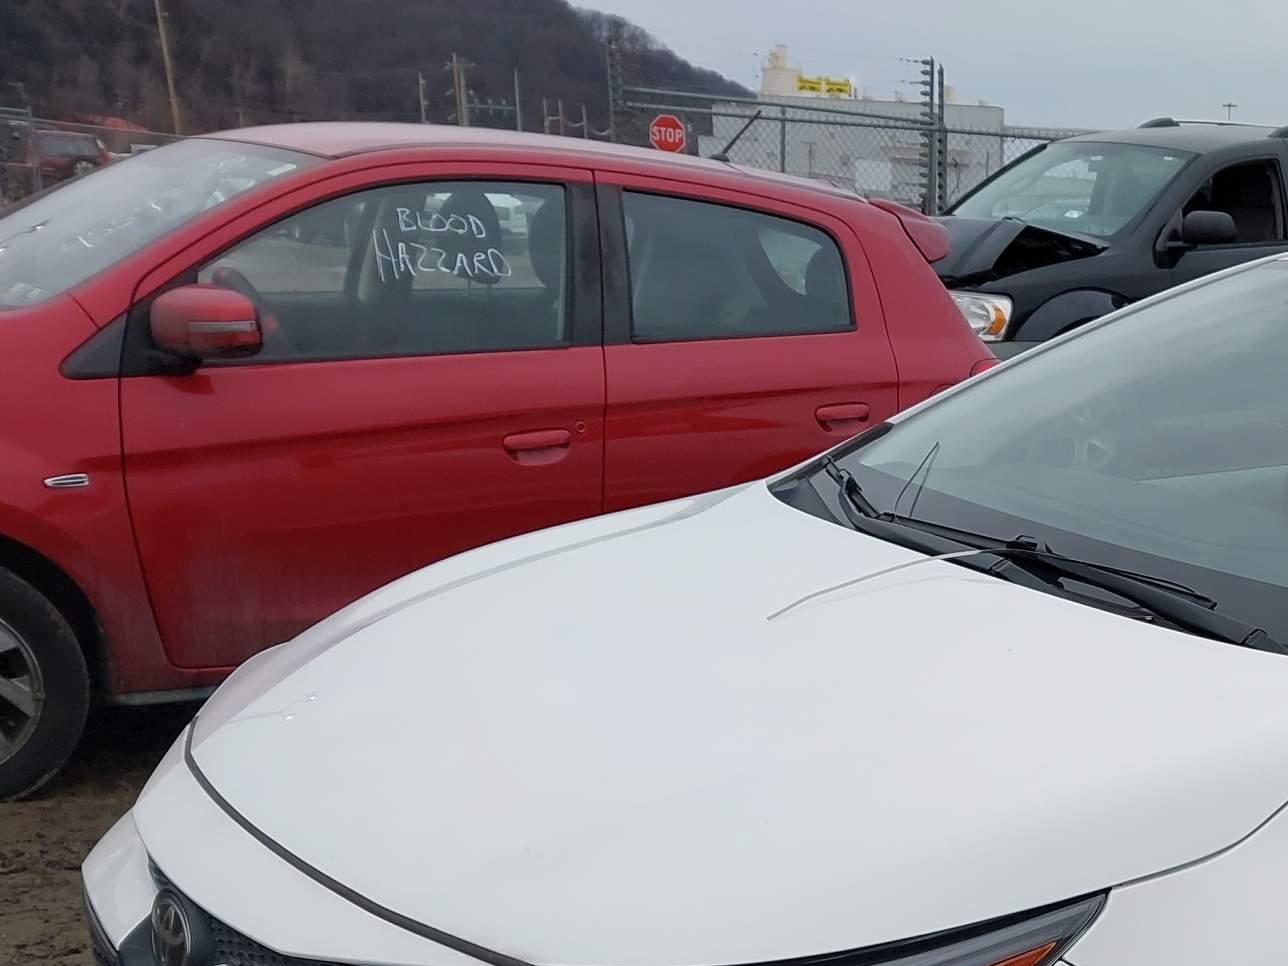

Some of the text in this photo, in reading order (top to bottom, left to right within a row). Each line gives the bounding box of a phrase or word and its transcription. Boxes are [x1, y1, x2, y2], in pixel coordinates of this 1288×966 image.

[652, 126, 683, 143] STOP
[396, 208, 486, 238] BLOOD
[372, 228, 512, 283] HAZZARD
